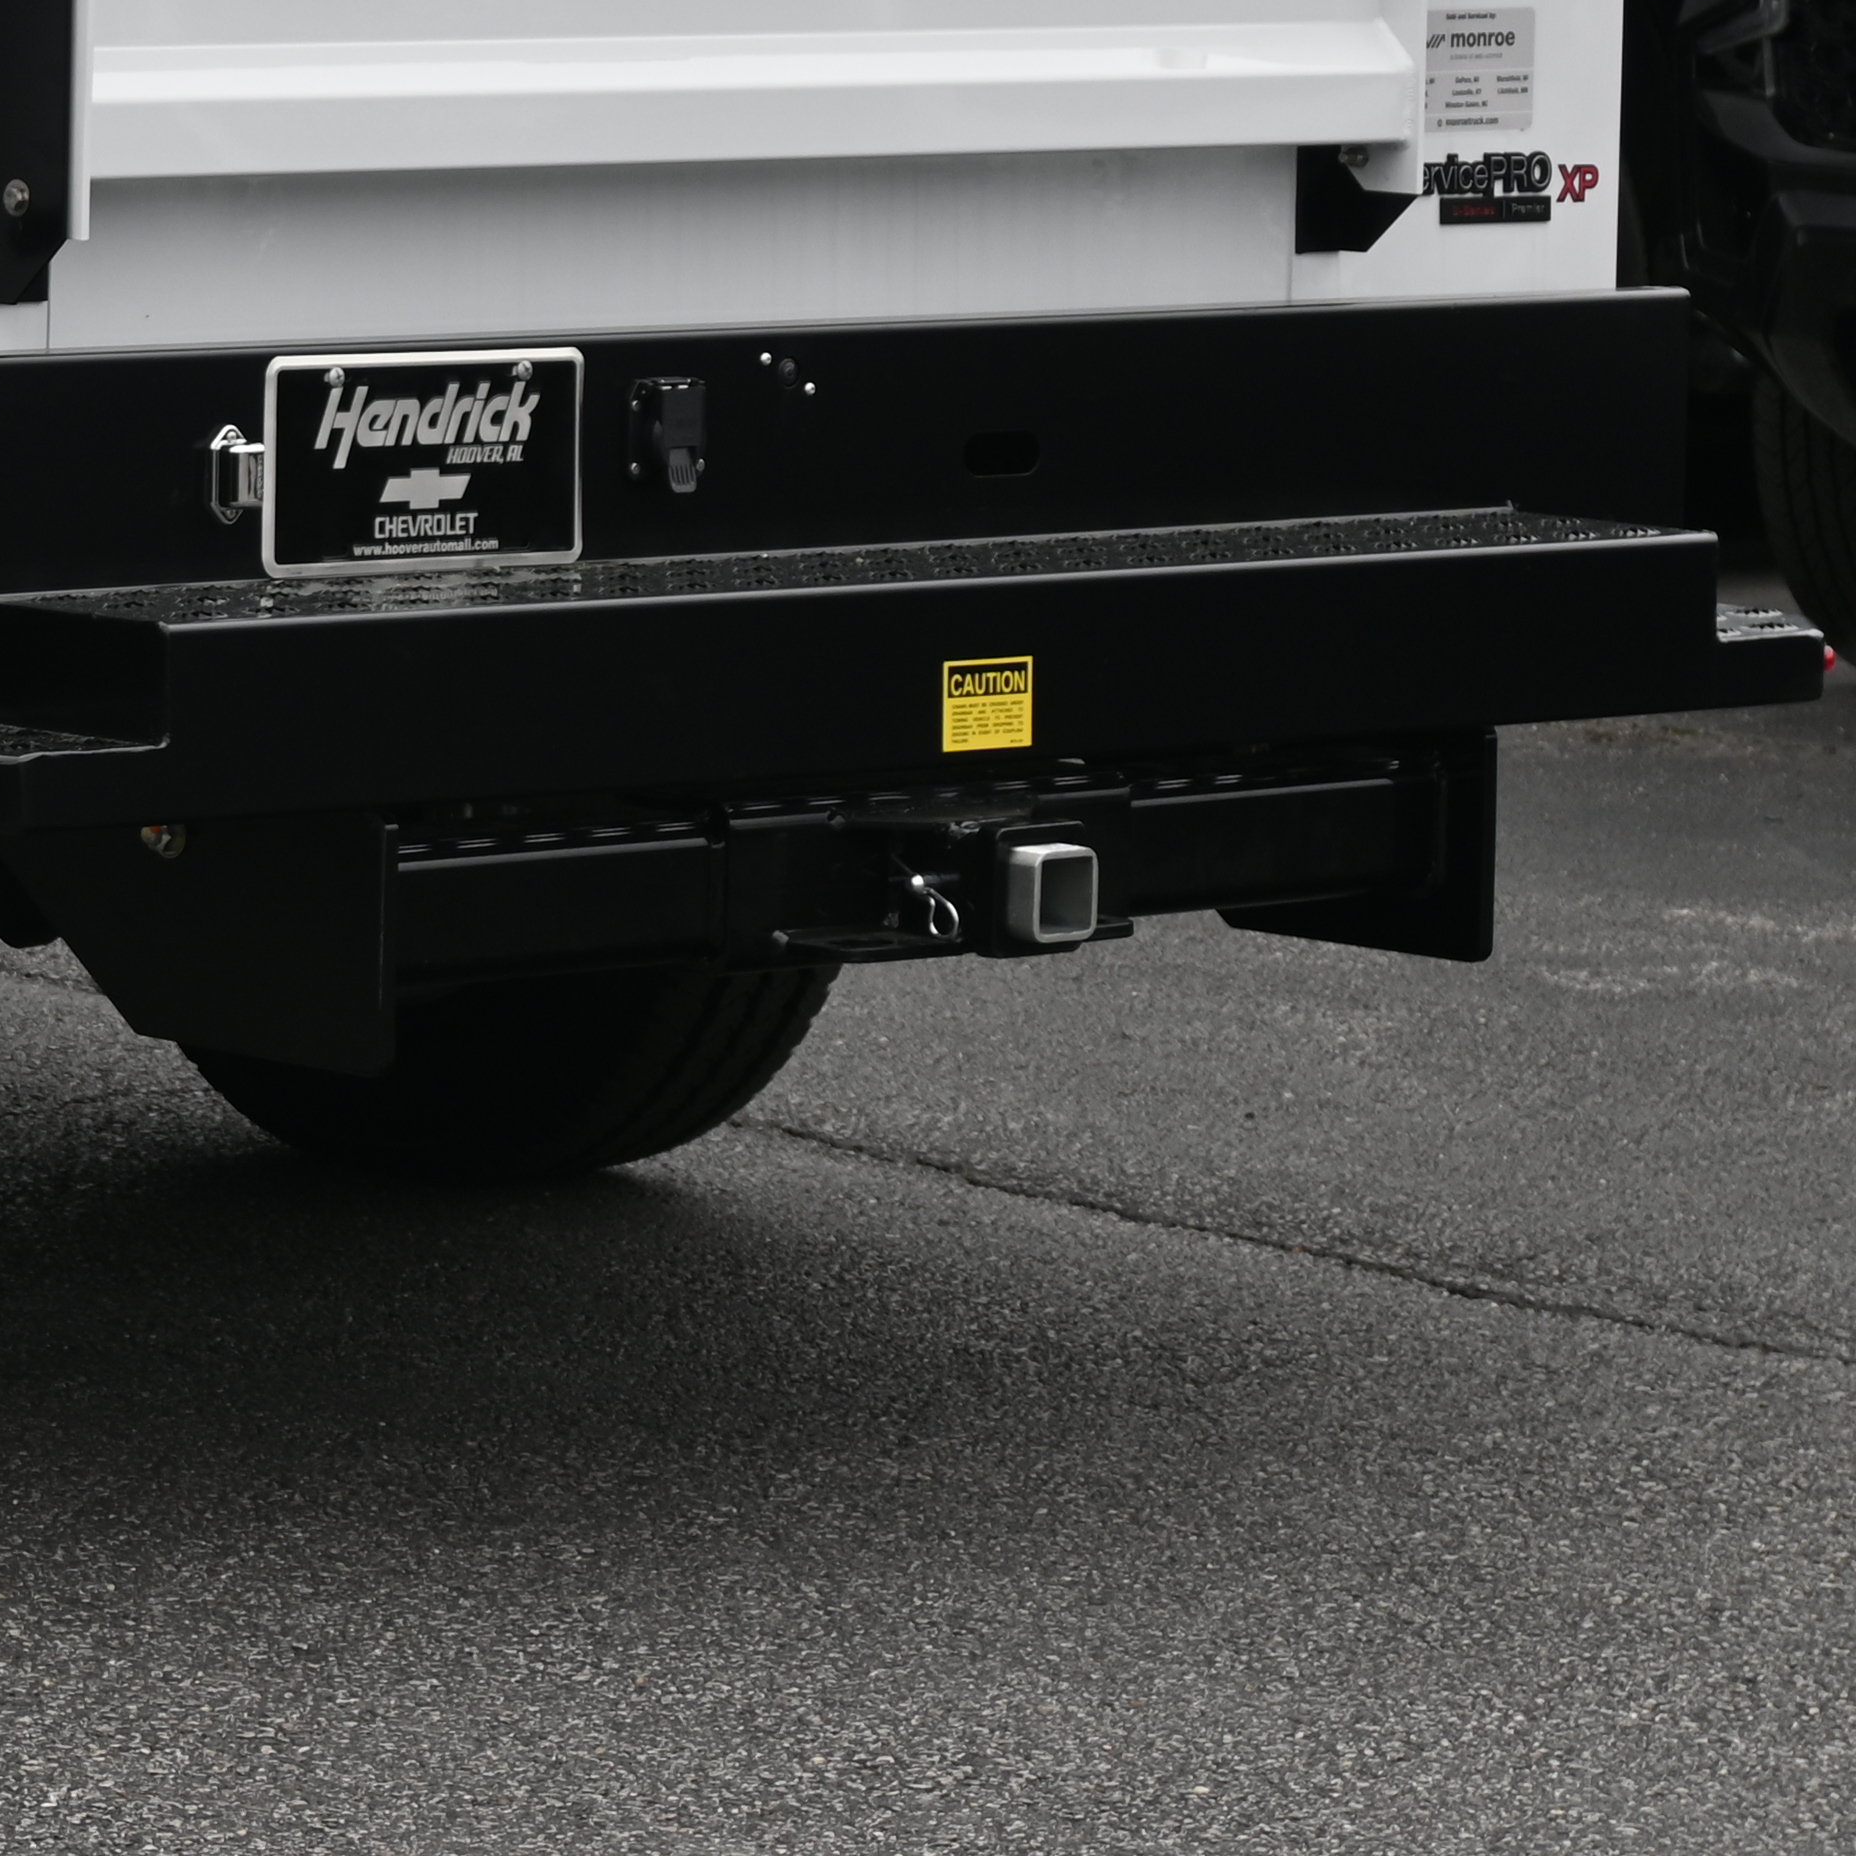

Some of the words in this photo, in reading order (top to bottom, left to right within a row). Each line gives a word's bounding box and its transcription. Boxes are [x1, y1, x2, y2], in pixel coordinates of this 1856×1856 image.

[1451, 31, 1515, 48] monroe
[1423, 151, 1552, 196] ervicePRO
[1556, 164, 1599, 203] XP
[313, 380, 541, 470] Hendrick
[446, 446, 504, 465] HOOVER,
[506, 444, 525, 462] AL
[373, 512, 478, 540] CHEVROLET
[353, 538, 500, 557] www.hooverautomall.com
[950, 670, 1026, 696] CAUTION
